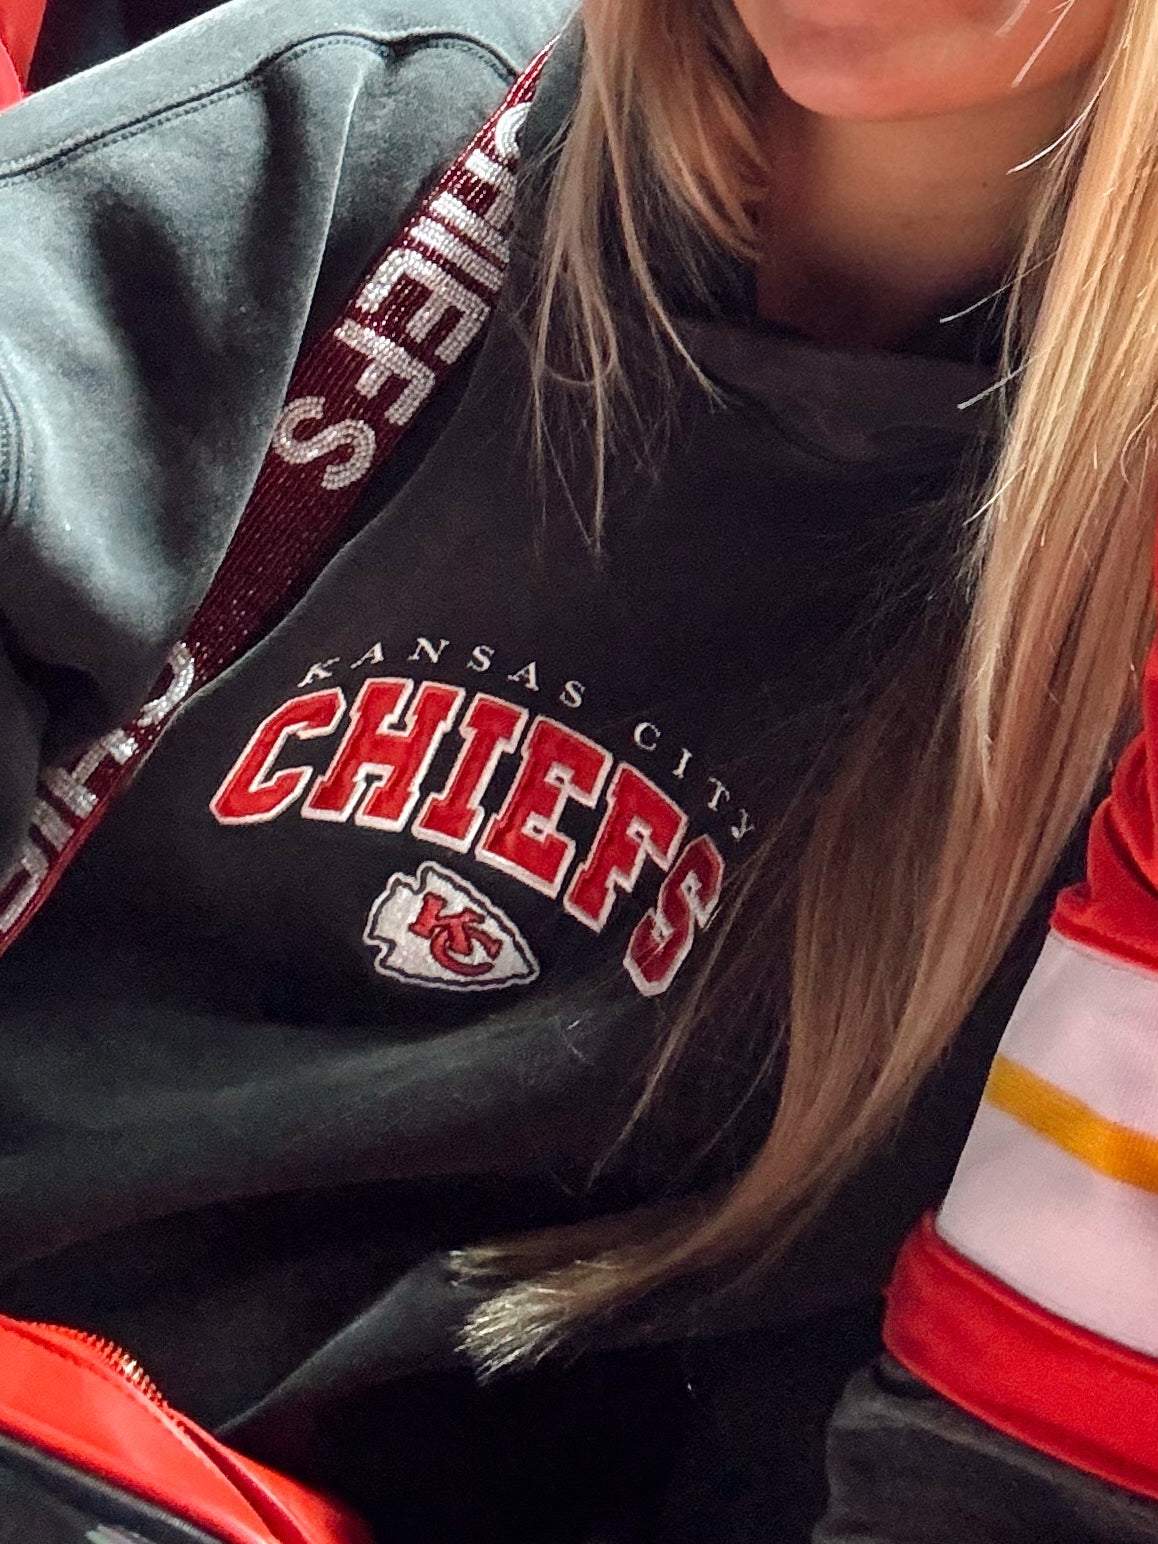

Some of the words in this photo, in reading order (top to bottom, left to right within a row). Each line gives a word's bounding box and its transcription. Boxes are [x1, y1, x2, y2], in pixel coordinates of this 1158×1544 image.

[208, 675, 726, 998] CHIEFS
[297, 636, 588, 709] KANSAS
[632, 721, 758, 842] CITY
